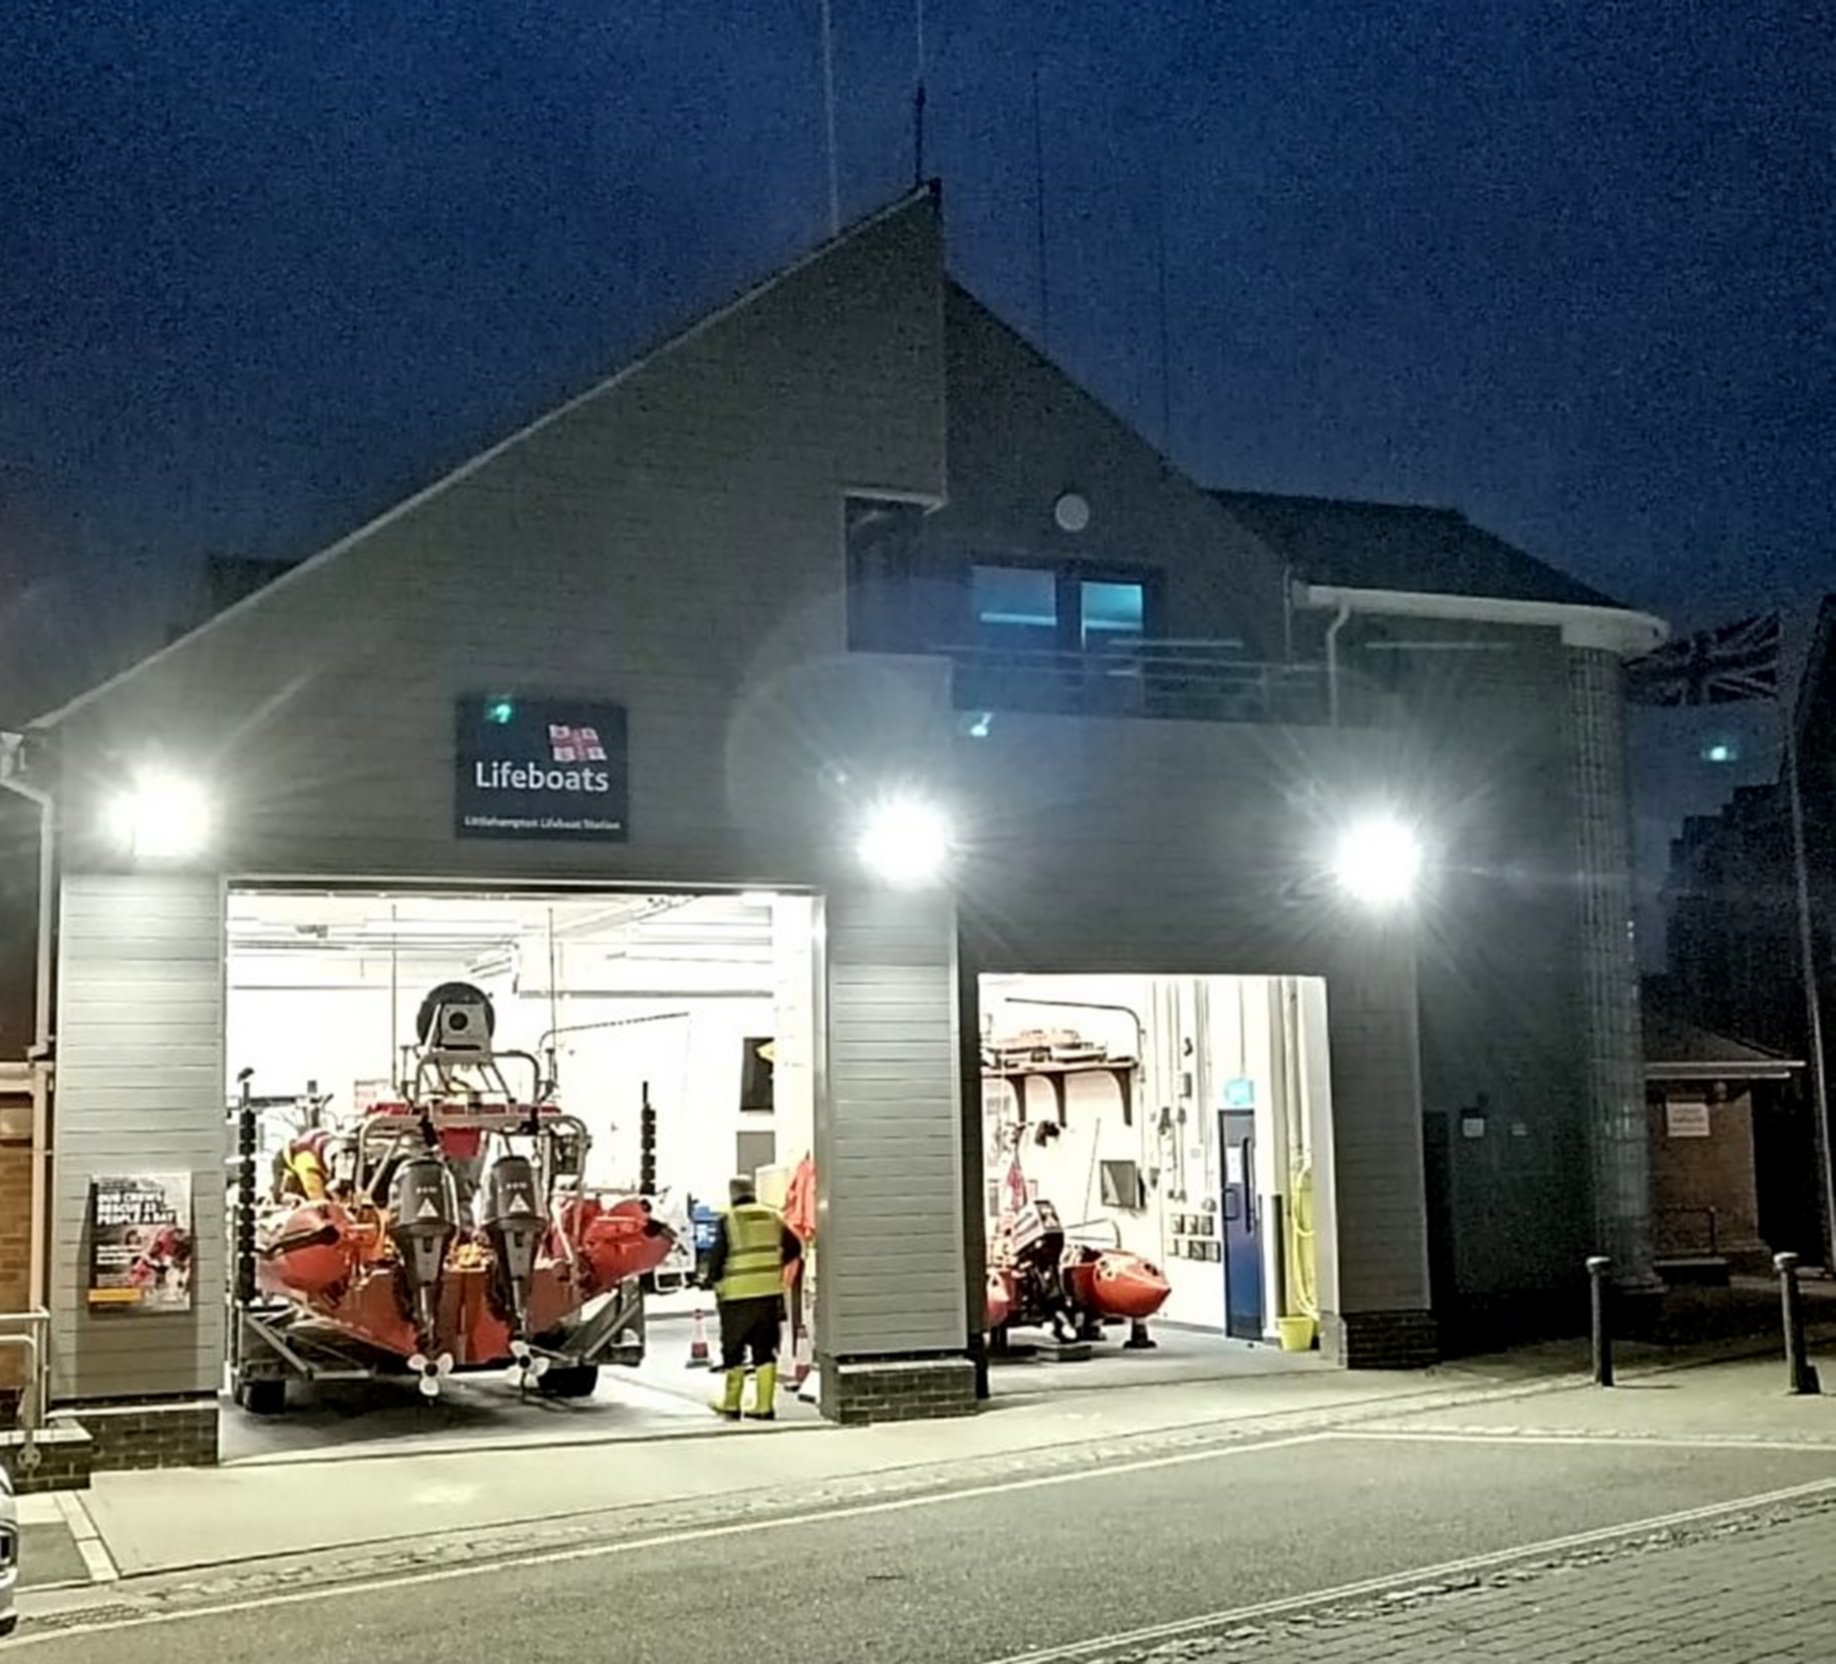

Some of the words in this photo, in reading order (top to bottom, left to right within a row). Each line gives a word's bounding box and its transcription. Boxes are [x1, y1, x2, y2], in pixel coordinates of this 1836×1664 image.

[476, 761, 609, 792] Lifeboats
[540, 818, 581, 829] Lifeboat
[583, 819, 621, 830] Station
